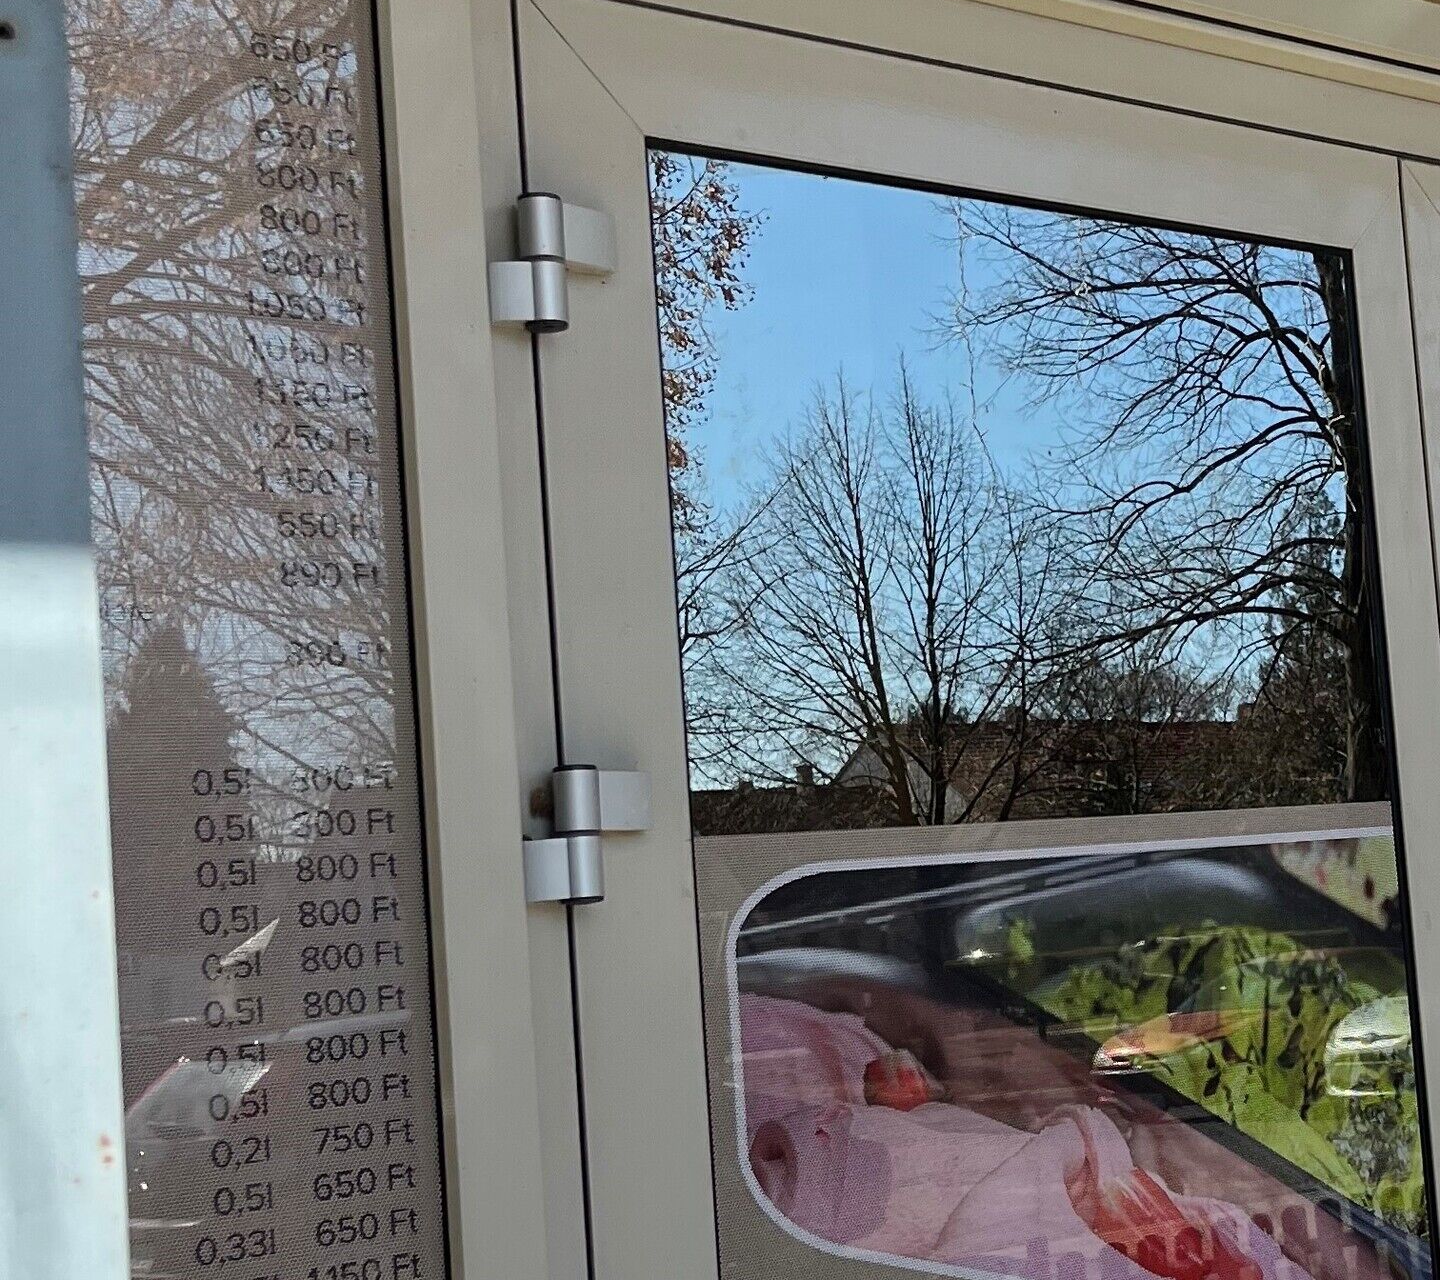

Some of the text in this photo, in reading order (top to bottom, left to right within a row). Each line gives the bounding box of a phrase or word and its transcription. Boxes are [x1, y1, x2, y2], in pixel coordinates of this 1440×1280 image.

[195, 815, 254, 845] 0,5l
[367, 808, 396, 835] Ft
[197, 853, 398, 890] 0,5l 800 Ft
[200, 897, 400, 936] 0,5l 800 Ft
[301, 943, 363, 972] 800
[375, 941, 404, 968] Ft
[304, 988, 366, 1018] 800
[377, 985, 405, 1012] Ft
[306, 1034, 369, 1064] 800
[380, 1030, 408, 1058] Ft
[309, 1079, 371, 1109] 800
[382, 1074, 412, 1103] Ft
[212, 1119, 414, 1169] 0,2l 750 Ft
[214, 1163, 416, 1216] 0,5l 650 Ft
[196, 1208, 419, 1266] 0,33l 650 Ft
